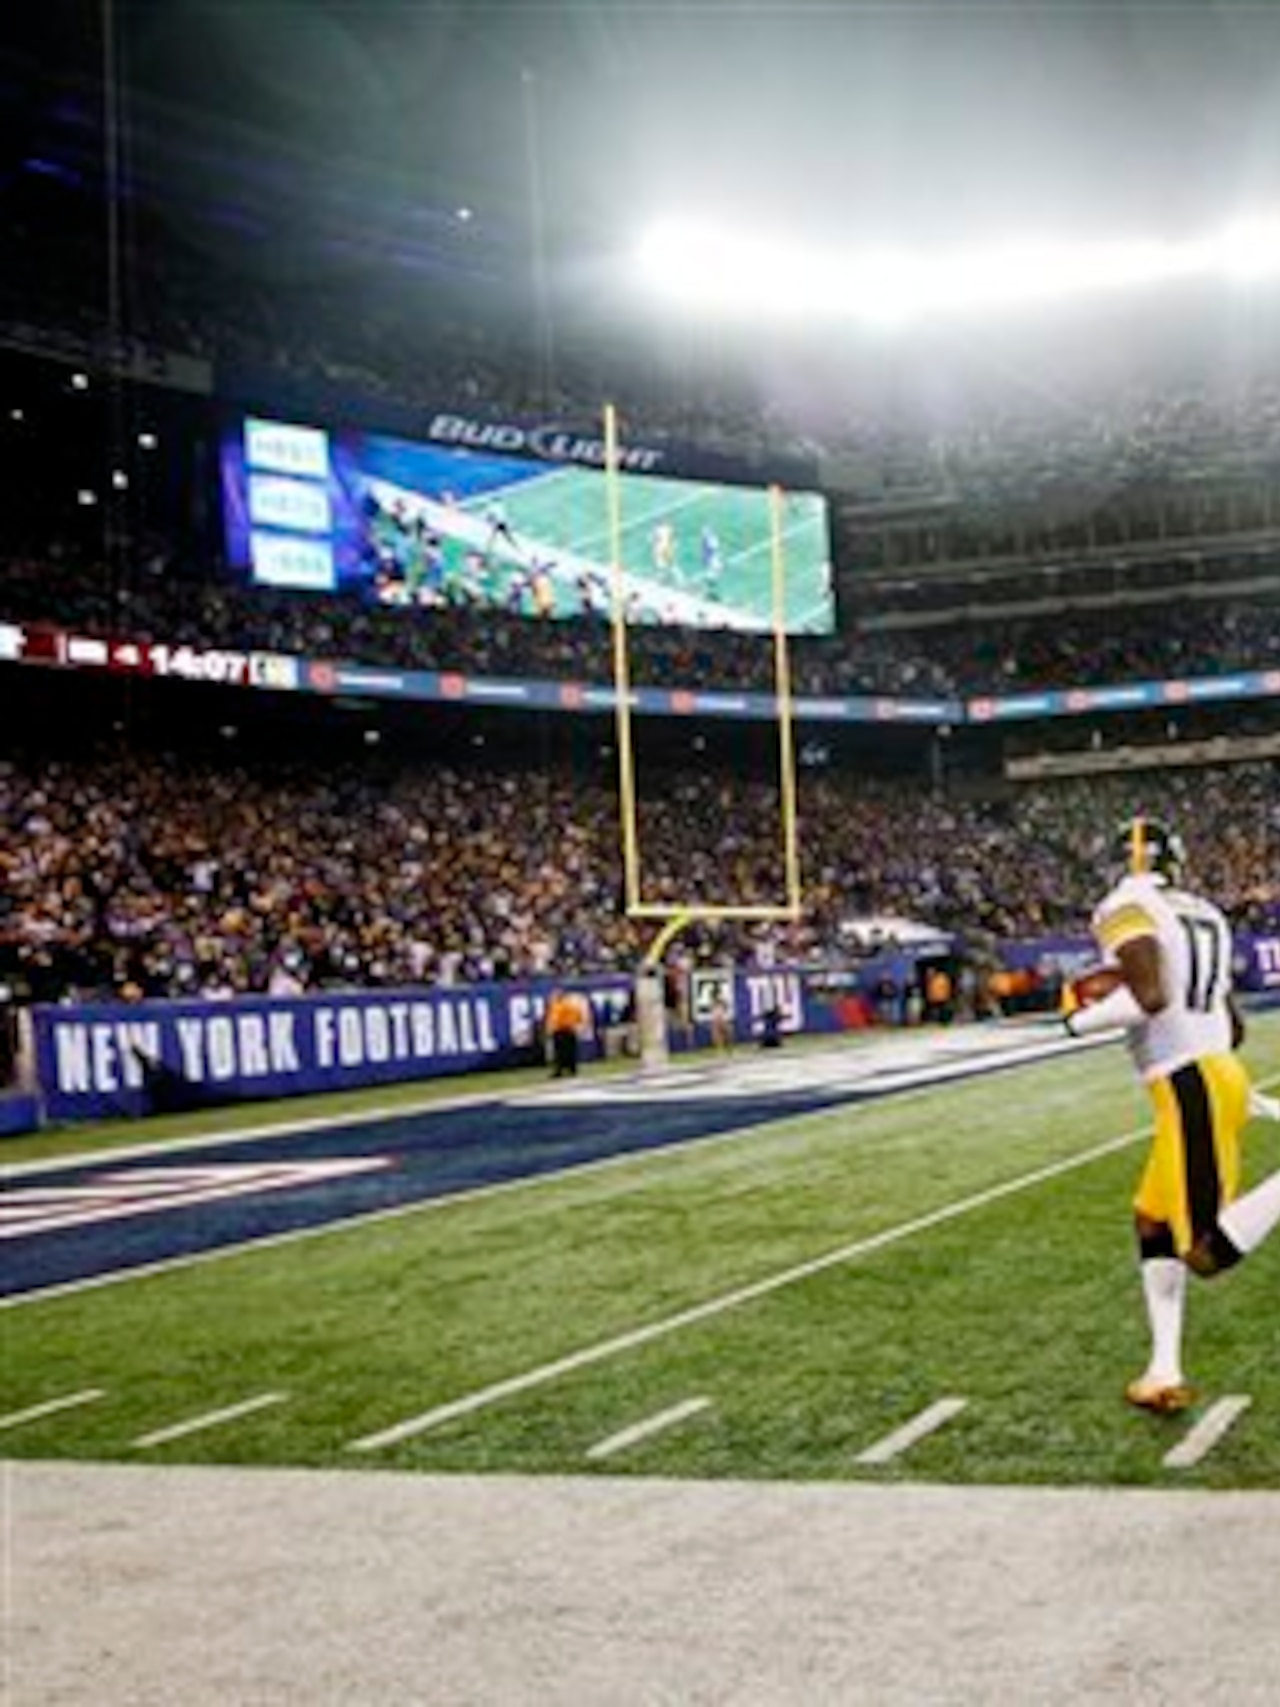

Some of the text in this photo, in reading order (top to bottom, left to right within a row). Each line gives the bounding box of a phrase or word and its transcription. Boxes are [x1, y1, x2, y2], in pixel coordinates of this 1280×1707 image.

[429, 413, 664, 469] BUD LIGHT
[150, 644, 246, 682] 14:07
[1177, 913, 1219, 1013] 17
[55, 1020, 159, 1092] NEW
[175, 1010, 298, 1082] YORK
[314, 998, 498, 1068] FOOTBALL
